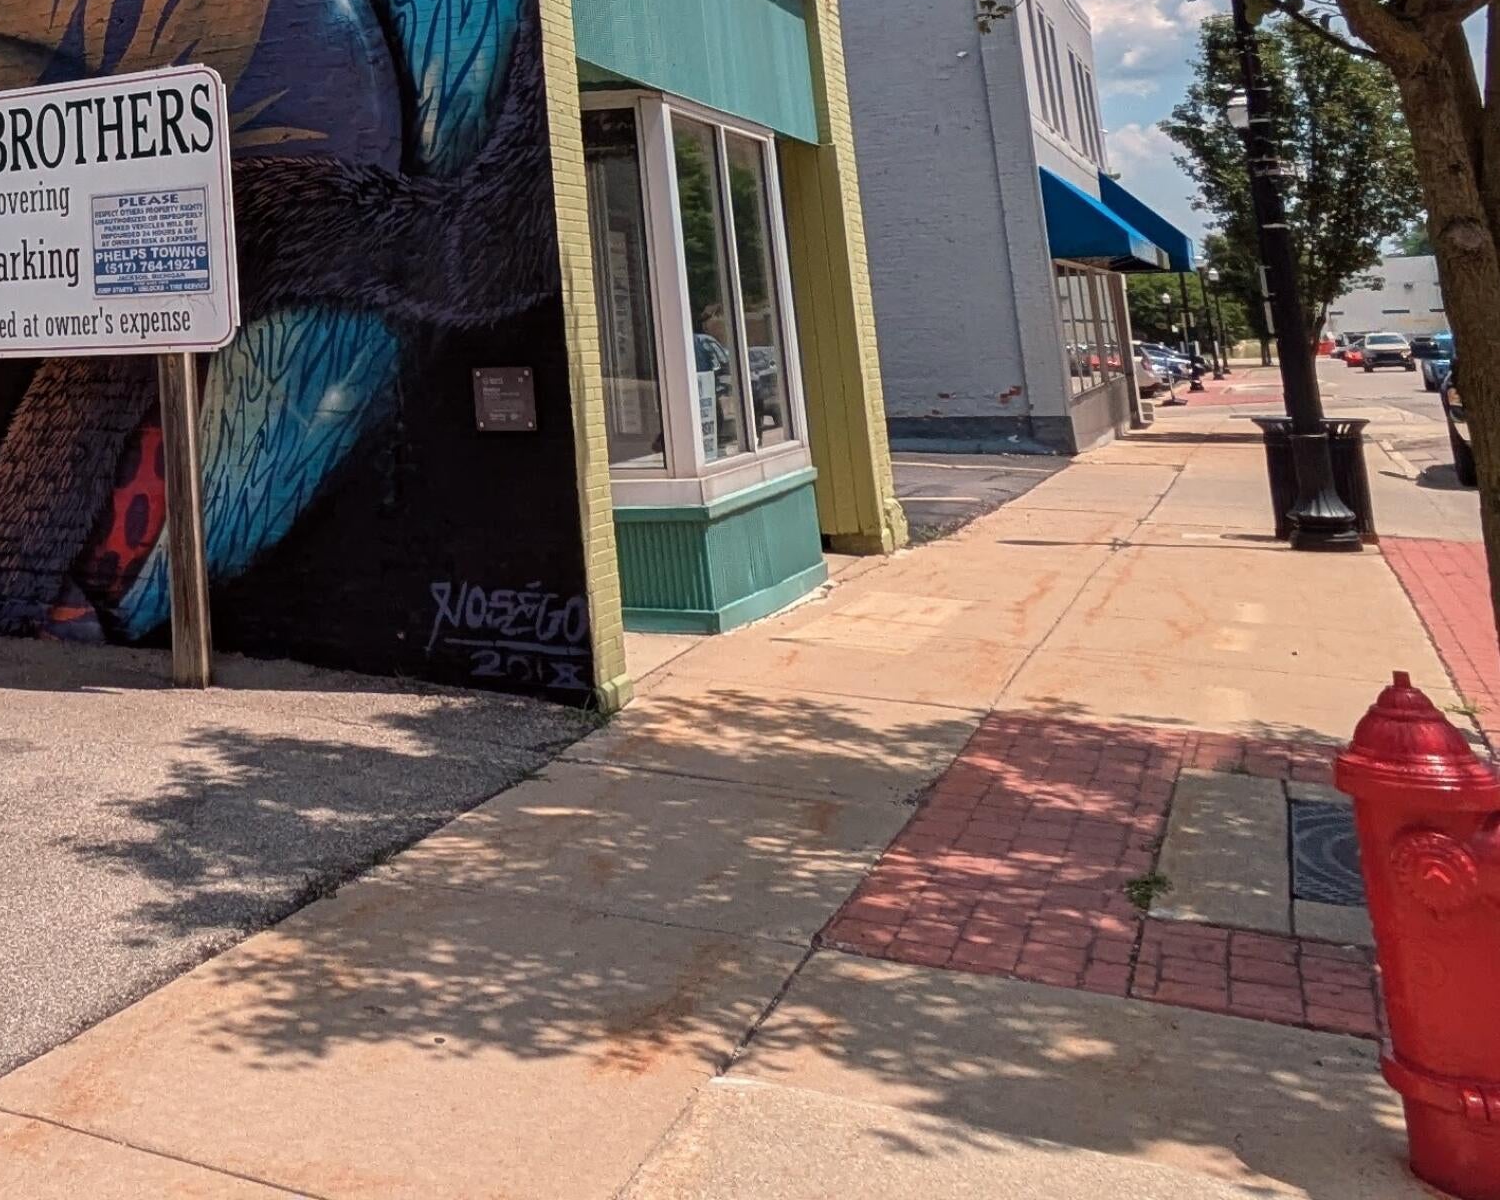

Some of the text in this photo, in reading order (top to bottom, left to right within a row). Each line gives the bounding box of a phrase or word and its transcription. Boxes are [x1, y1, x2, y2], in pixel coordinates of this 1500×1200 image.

[118, 193, 180, 208] PLEASE
[145, 205, 179, 214] PROPERTY
[104, 224, 130, 232] PARKED
[131, 222, 165, 230] VEHICLES
[166, 220, 183, 228] WILL
[95, 246, 207, 264] PHELPS TOWING
[105, 258, 197, 274] (517) 764-1921
[23, 313, 40, 338] at
[45, 306, 114, 337] owner's
[119, 310, 191, 339] expense
